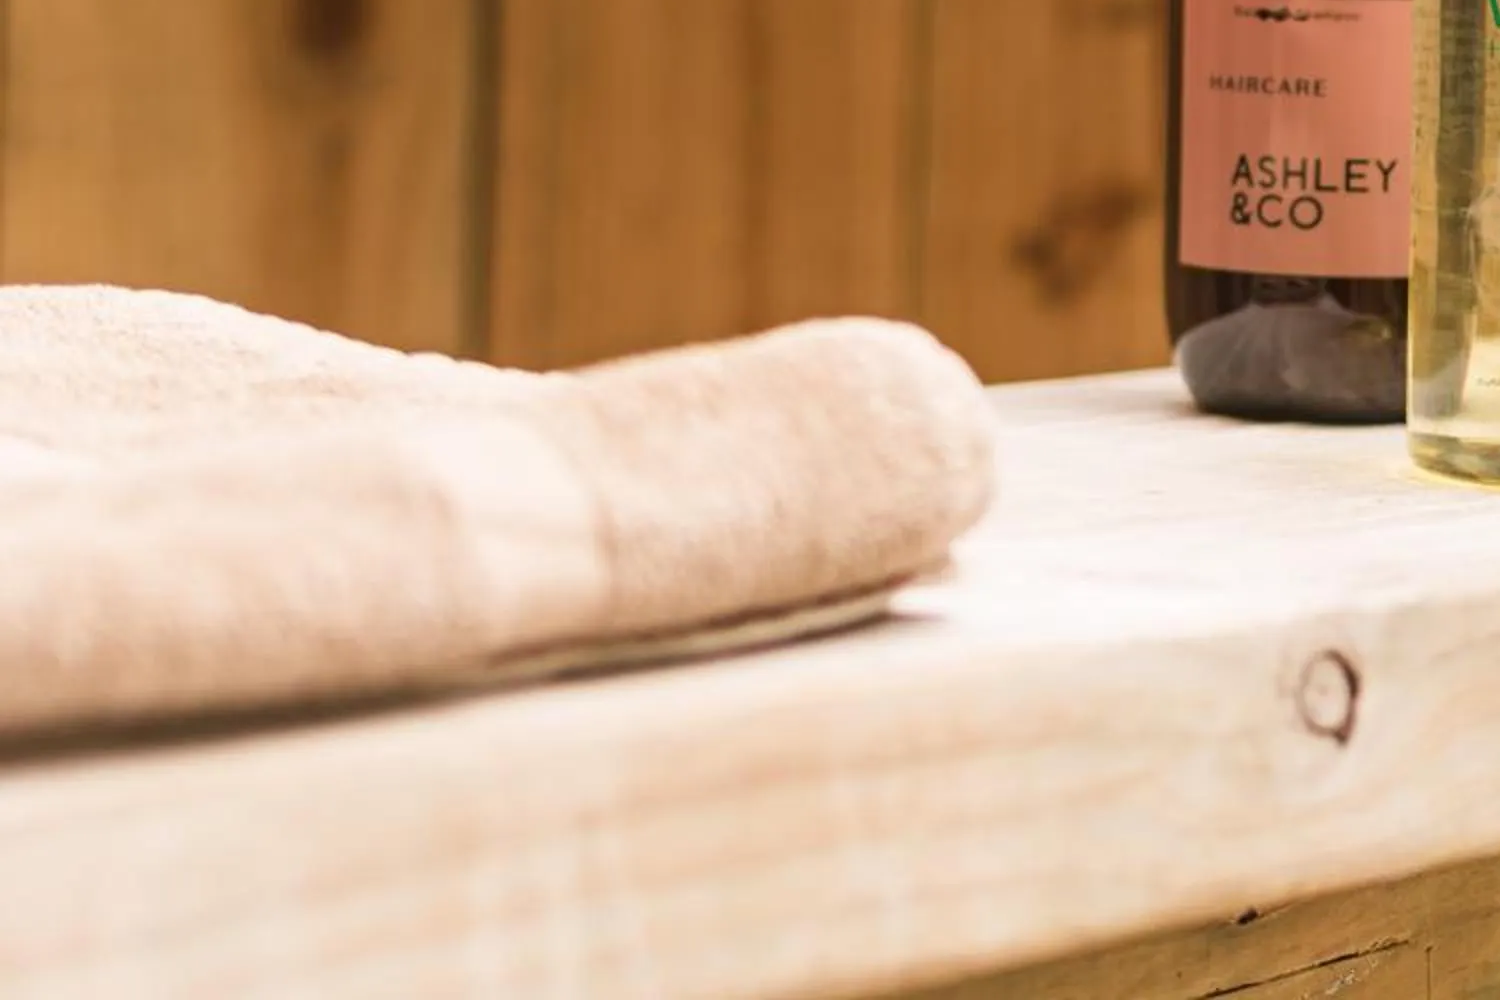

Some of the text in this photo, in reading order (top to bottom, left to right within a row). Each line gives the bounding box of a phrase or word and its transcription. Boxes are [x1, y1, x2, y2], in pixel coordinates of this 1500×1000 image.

[1208, 75, 1328, 97] HAIRCARE
[1230, 153, 1399, 194] ASHLEY
[1229, 192, 1325, 231] &CO
